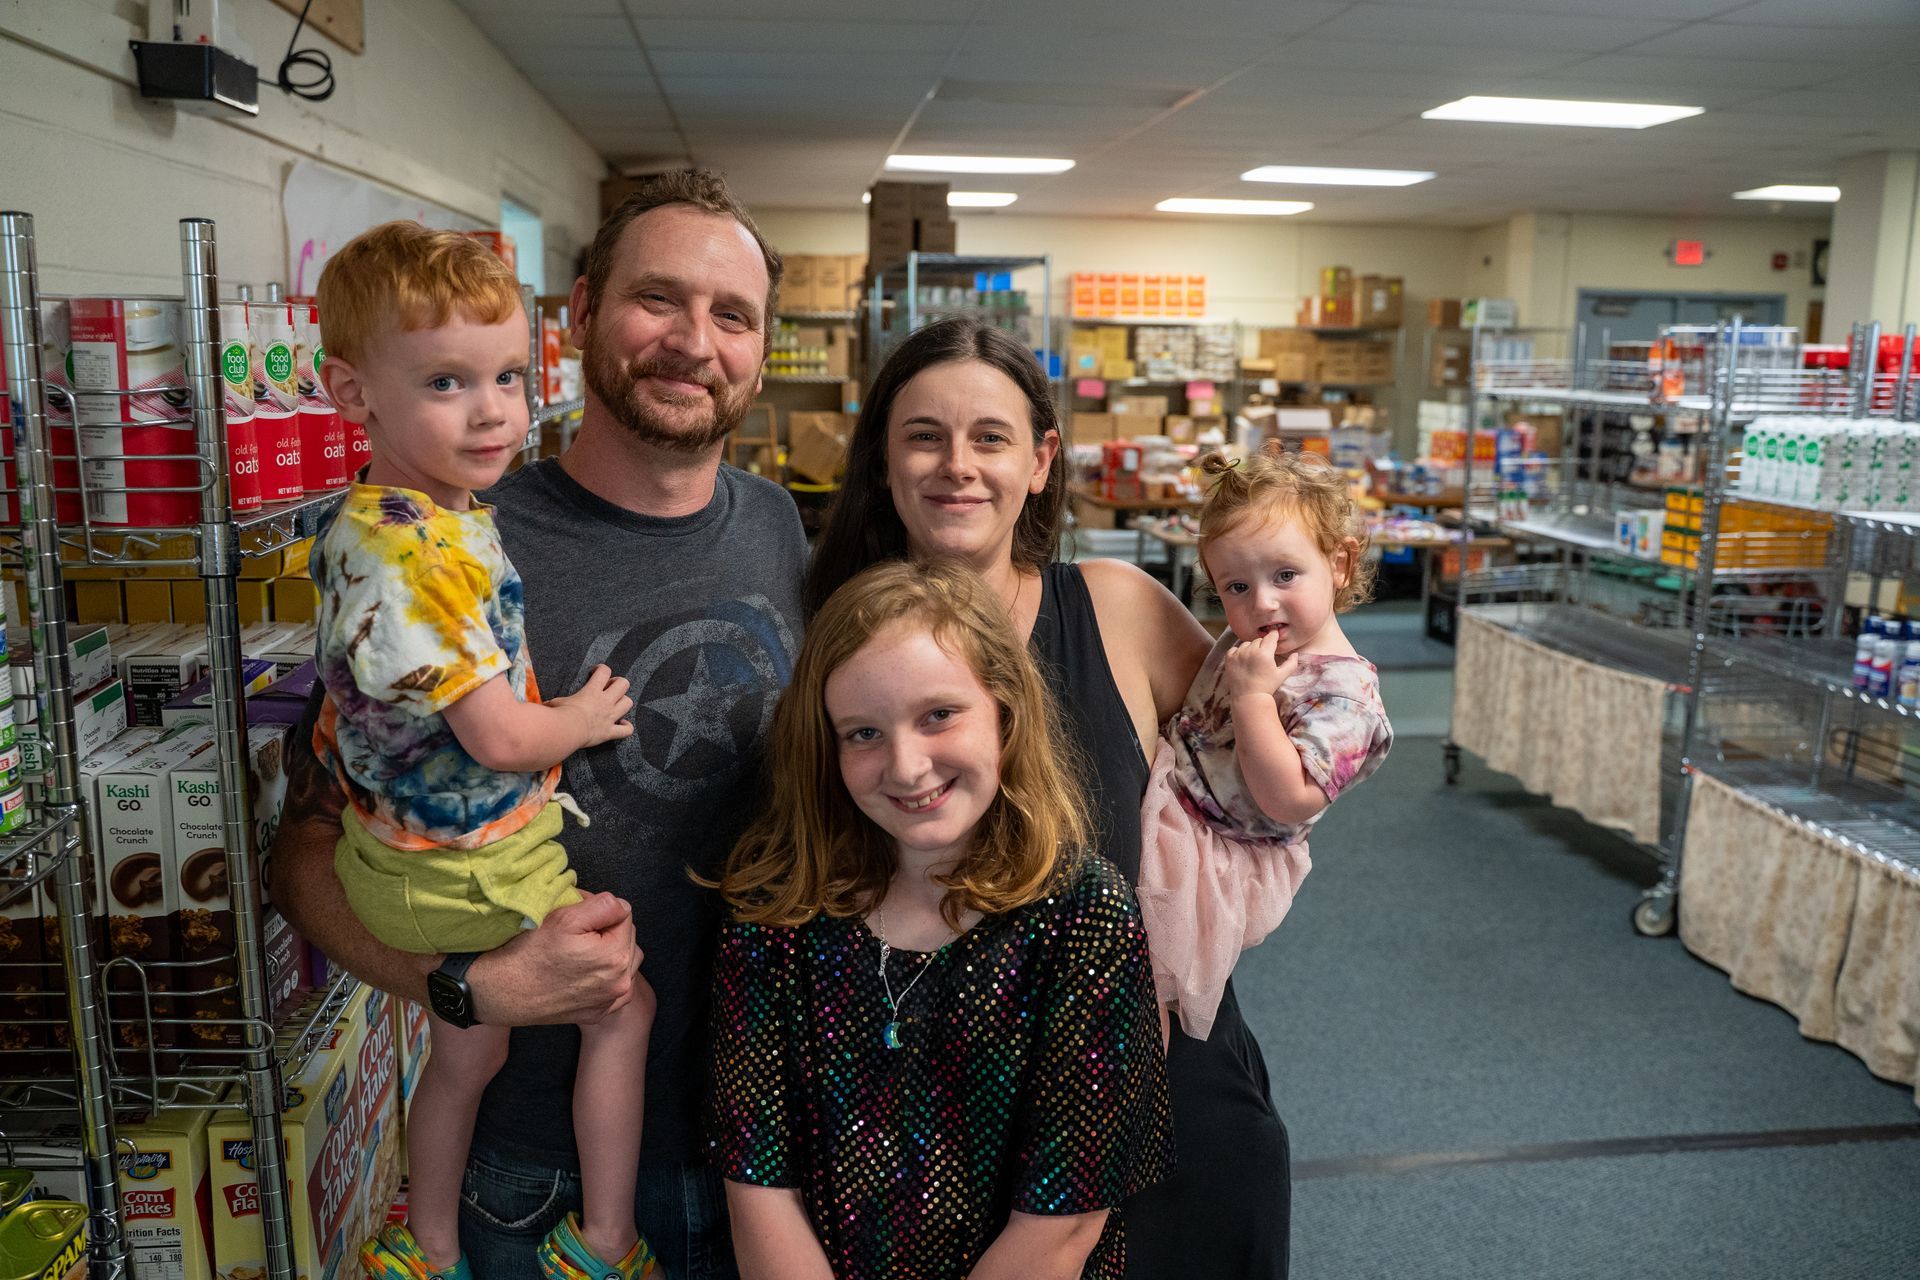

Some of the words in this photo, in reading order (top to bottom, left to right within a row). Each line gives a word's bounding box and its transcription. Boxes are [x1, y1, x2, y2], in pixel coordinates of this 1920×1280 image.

[227, 352, 245, 363] food
[271, 352, 289, 363] food
[229, 363, 245, 374] club
[272, 363, 289, 373] club
[324, 432, 335, 441] old
[353, 426, 365, 436] old
[276, 437, 289, 448] old
[235, 444, 248, 455] old
[324, 443, 345, 458] oats
[276, 450, 301, 466] oats
[235, 457, 259, 475] oats
[106, 784, 150, 798] Kashi
[177, 780, 220, 794] Kashi
[117, 799, 141, 811] GO
[187, 795, 211, 807] GO
[109, 827, 154, 836] Chocolate
[180, 822, 223, 831] Chocolate
[116, 836, 148, 845] Crunch
[186, 831, 218, 839] Crunch
[361, 1013, 391, 1083] Corn
[360, 1037, 395, 1133] Flakes
[320, 1105, 355, 1192] Corn
[119, 1153, 167, 1168] Hopitality
[234, 1184, 258, 1198] Co
[318, 1129, 360, 1250] Flakes
[124, 1192, 165, 1204] Corn
[156, 1227, 181, 1236] Facts
[41, 1227, 87, 1280] SPAM
